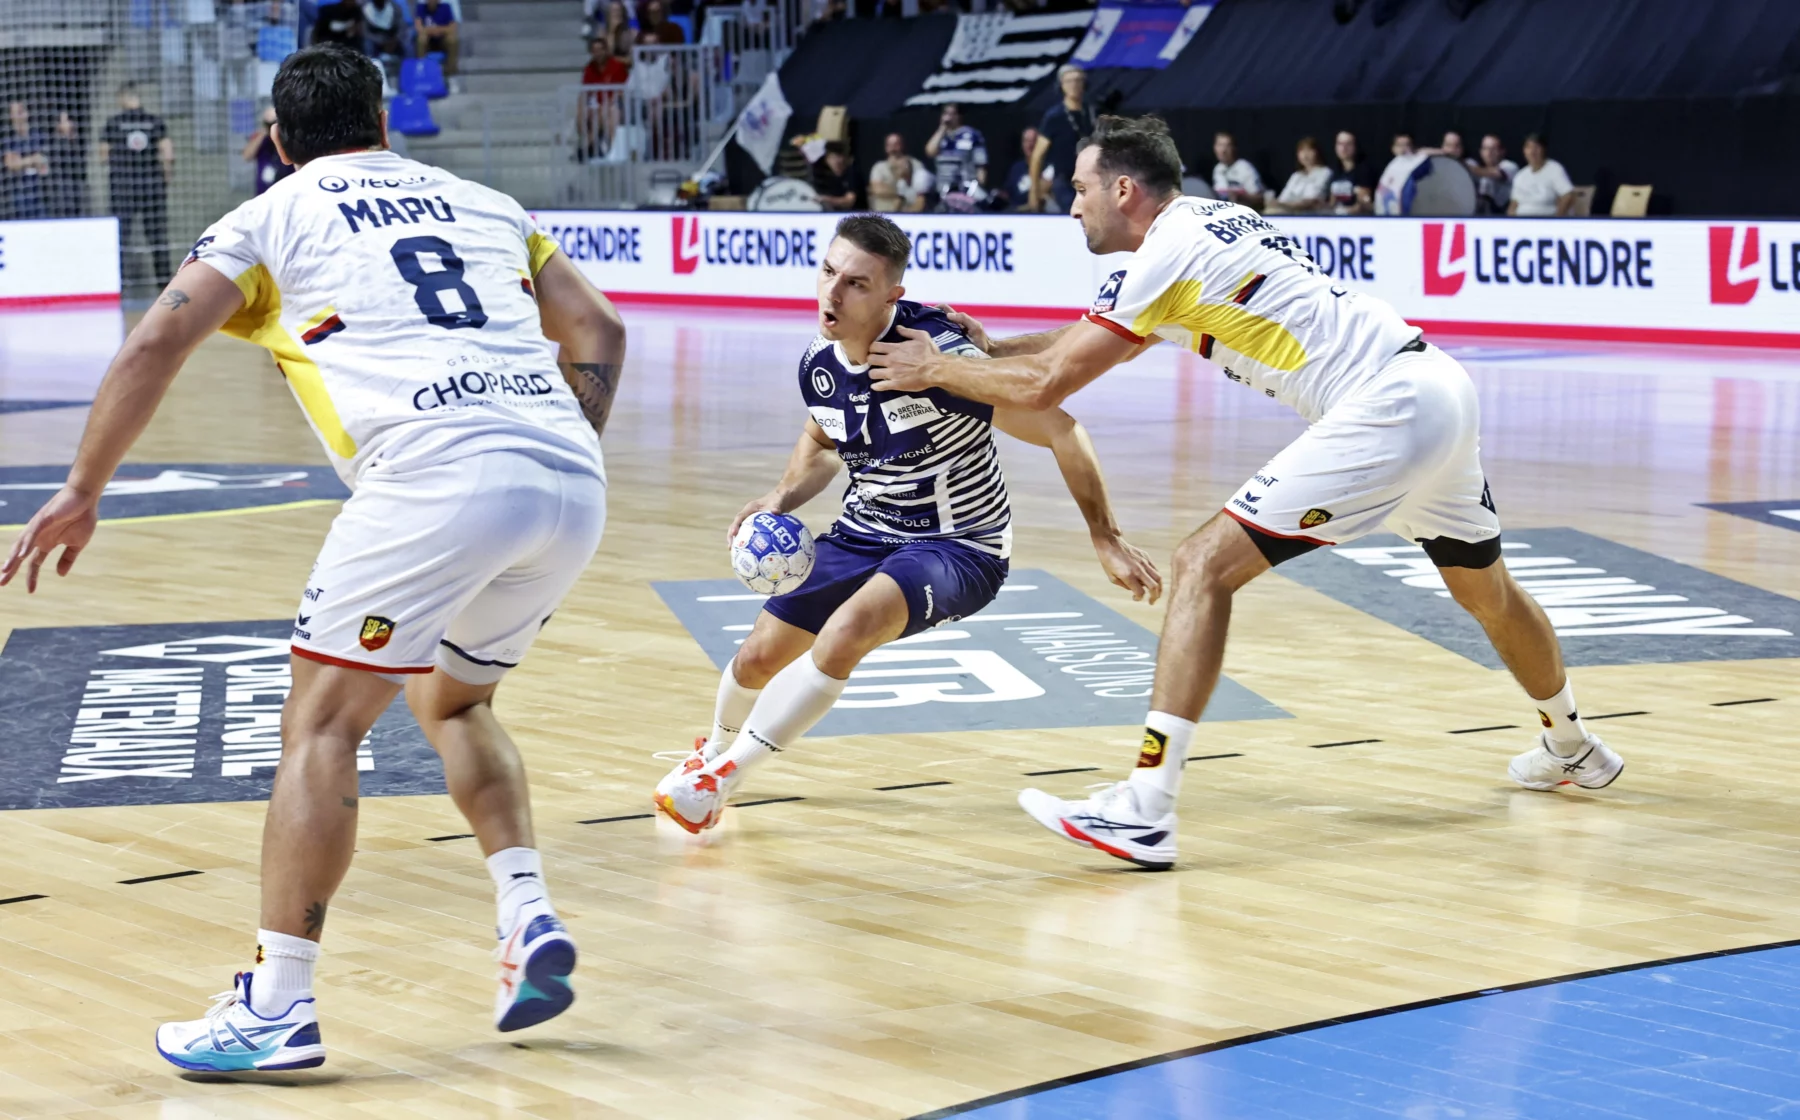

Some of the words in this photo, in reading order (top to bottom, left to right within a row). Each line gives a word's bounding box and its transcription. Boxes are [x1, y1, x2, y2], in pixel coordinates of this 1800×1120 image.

[338, 196, 456, 233] MAPU
[551, 226, 641, 263] GENDRE
[704, 228, 817, 267] LEGENDRE
[905, 232, 1014, 272] GENDRE
[1474, 238, 1654, 288] LEGENDRE
[390, 236, 488, 329] 8
[413, 371, 553, 411] CHOPARD
[897, 403, 925, 415] BRETA
[855, 404, 872, 445] 7
[845, 444, 934, 468] CESSON-SIGNÉ
[1233, 499, 1259, 515] erima
[755, 514, 797, 552] SELECT
[1003, 624, 1157, 698] MAISONS
[57, 668, 204, 783] MATERIAUX
